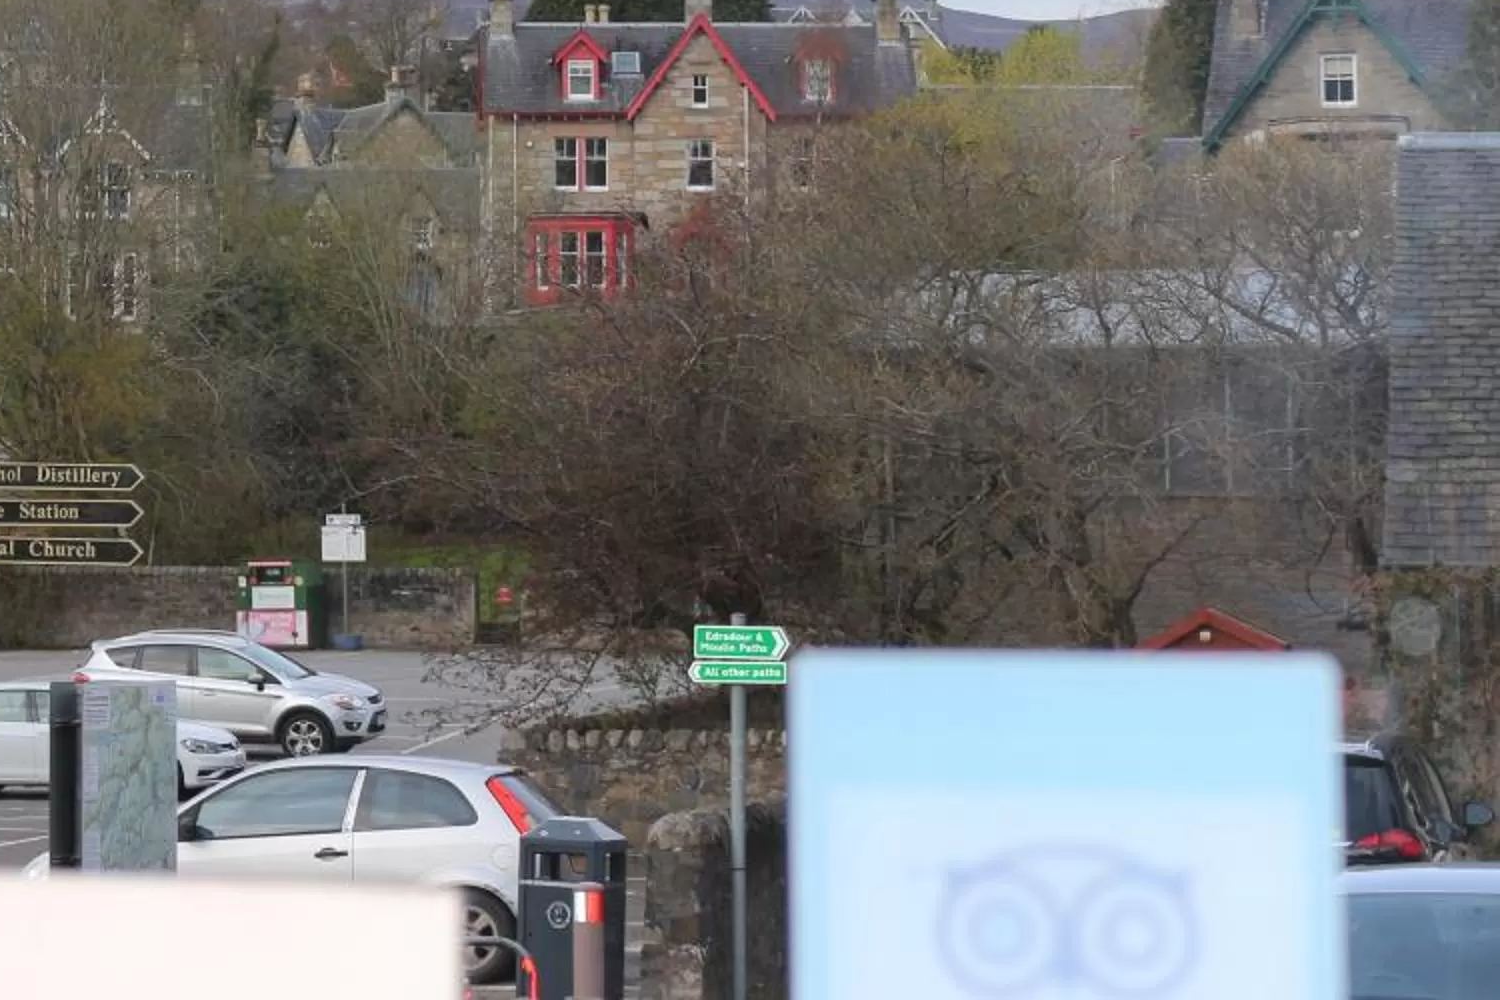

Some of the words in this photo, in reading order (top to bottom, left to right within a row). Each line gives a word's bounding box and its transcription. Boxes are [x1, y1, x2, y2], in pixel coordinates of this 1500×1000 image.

[36, 466, 121, 488] Distillery
[19, 503, 79, 520] Station
[29, 540, 96, 558] Church
[739, 643, 768, 653] Paths
[704, 667, 719, 677] All
[721, 667, 750, 677] other
[752, 667, 781, 679] paths
